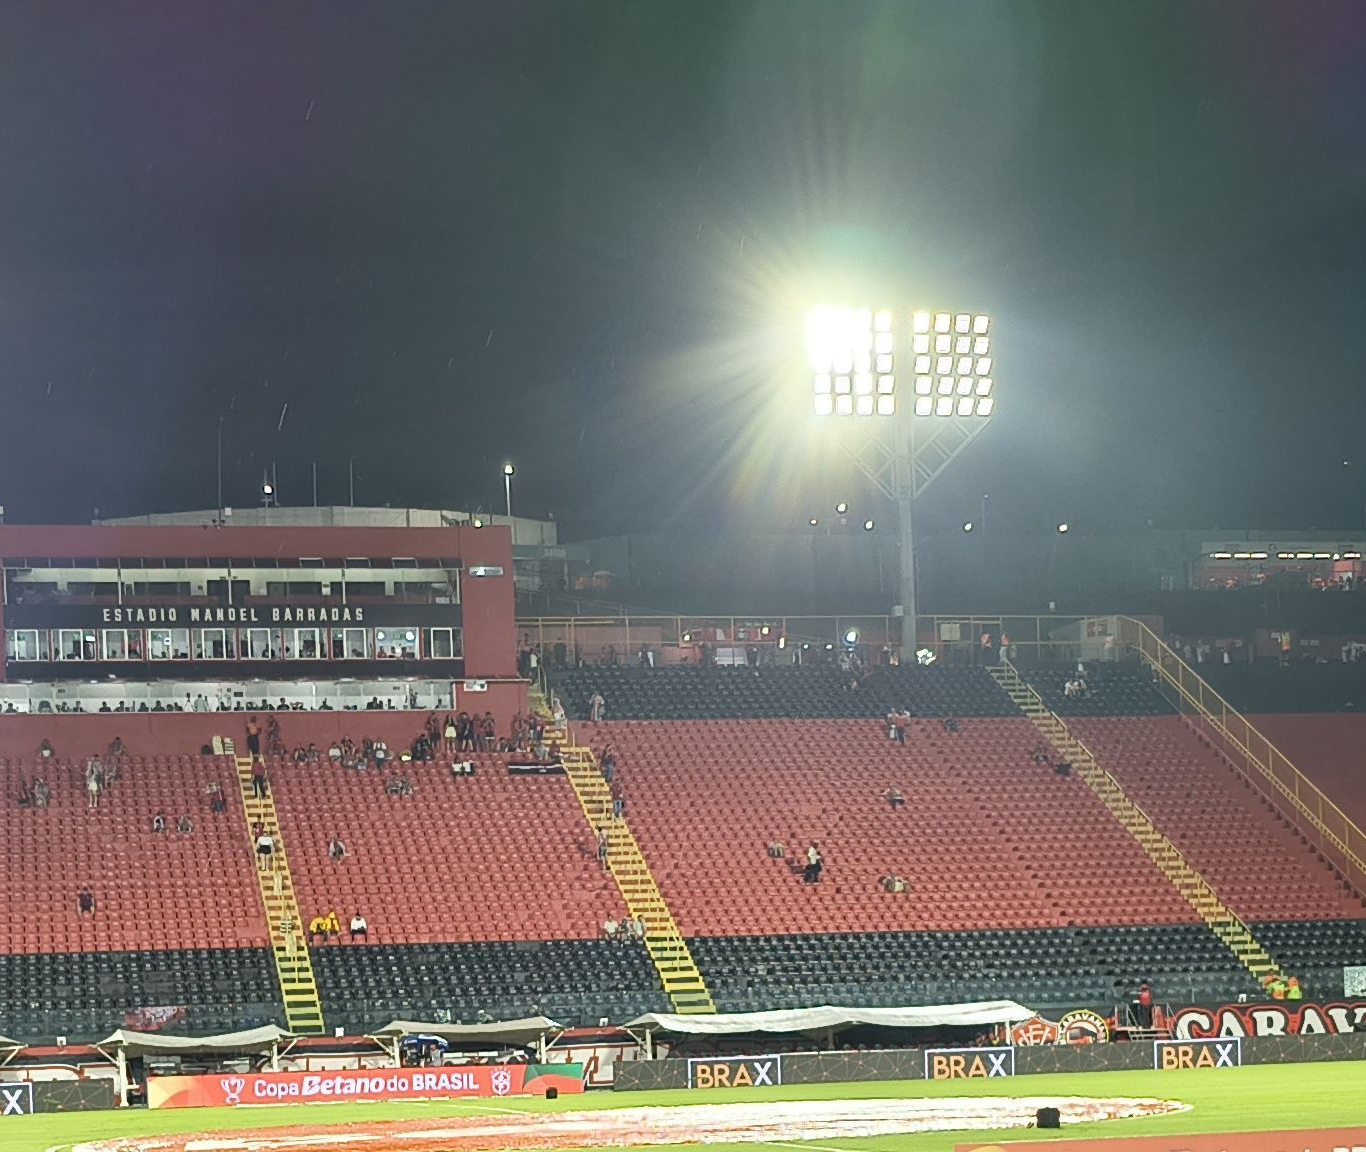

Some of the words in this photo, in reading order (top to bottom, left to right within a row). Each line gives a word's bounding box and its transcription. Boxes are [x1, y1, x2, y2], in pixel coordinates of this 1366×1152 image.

[191, 607, 259, 622] MANOEL
[272, 607, 364, 622] BARRADAS
[933, 1052, 1007, 1080] BRAX
[1162, 1042, 1233, 1070] BRAX
[253, 1079, 299, 1101] Copa
[301, 1075, 385, 1097] Betano
[386, 1075, 409, 1093] do
[412, 1072, 479, 1092] BRASIL
[696, 1061, 773, 1089] BRAX
